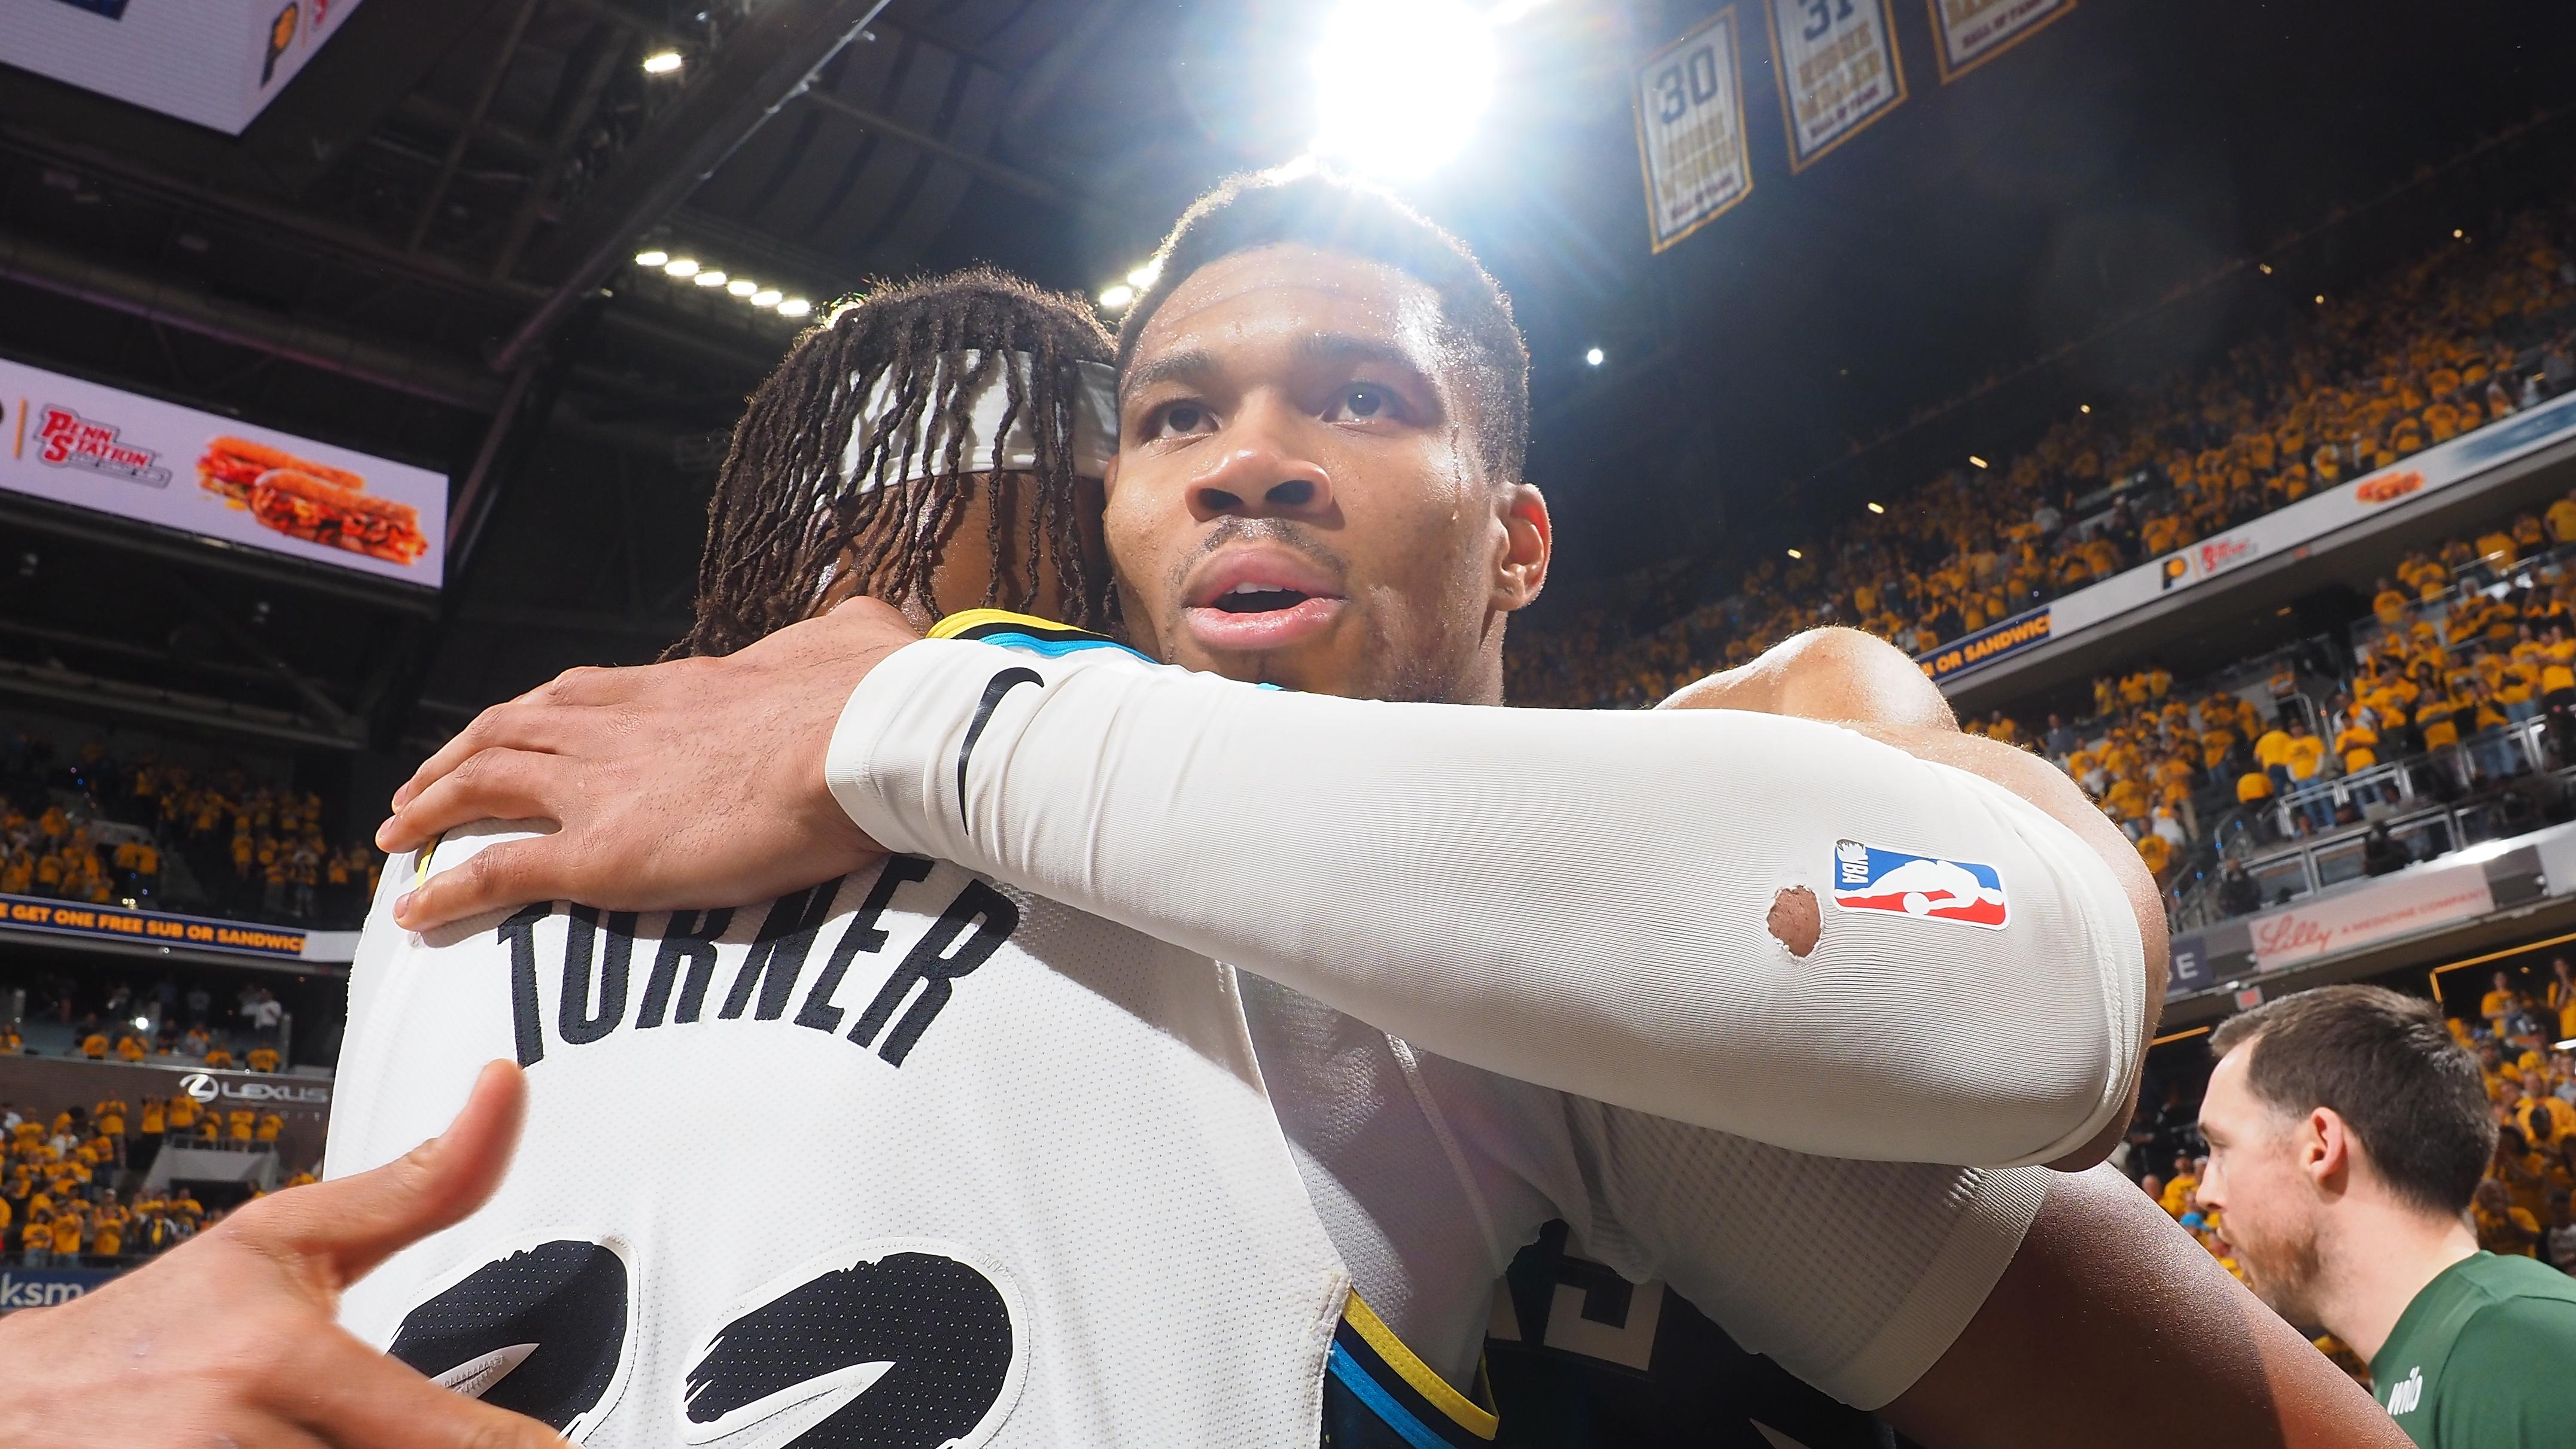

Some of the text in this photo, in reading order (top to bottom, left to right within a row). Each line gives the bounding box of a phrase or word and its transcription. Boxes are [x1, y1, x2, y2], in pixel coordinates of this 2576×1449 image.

[1657, 43, 1718, 124] 30
[1936, 650, 1963, 672] OR
[1963, 614, 2051, 662] SANDWIC
[11, 904, 51, 923] GET
[53, 909, 95, 927] ONE
[98, 914, 144, 933] FREE
[146, 920, 184, 938] SUB
[186, 925, 214, 942] OR
[2257, 914, 2332, 956] Lilly
[497, 856, 1020, 1069] TURNER
[221, 1081, 329, 1103] LEXUS
